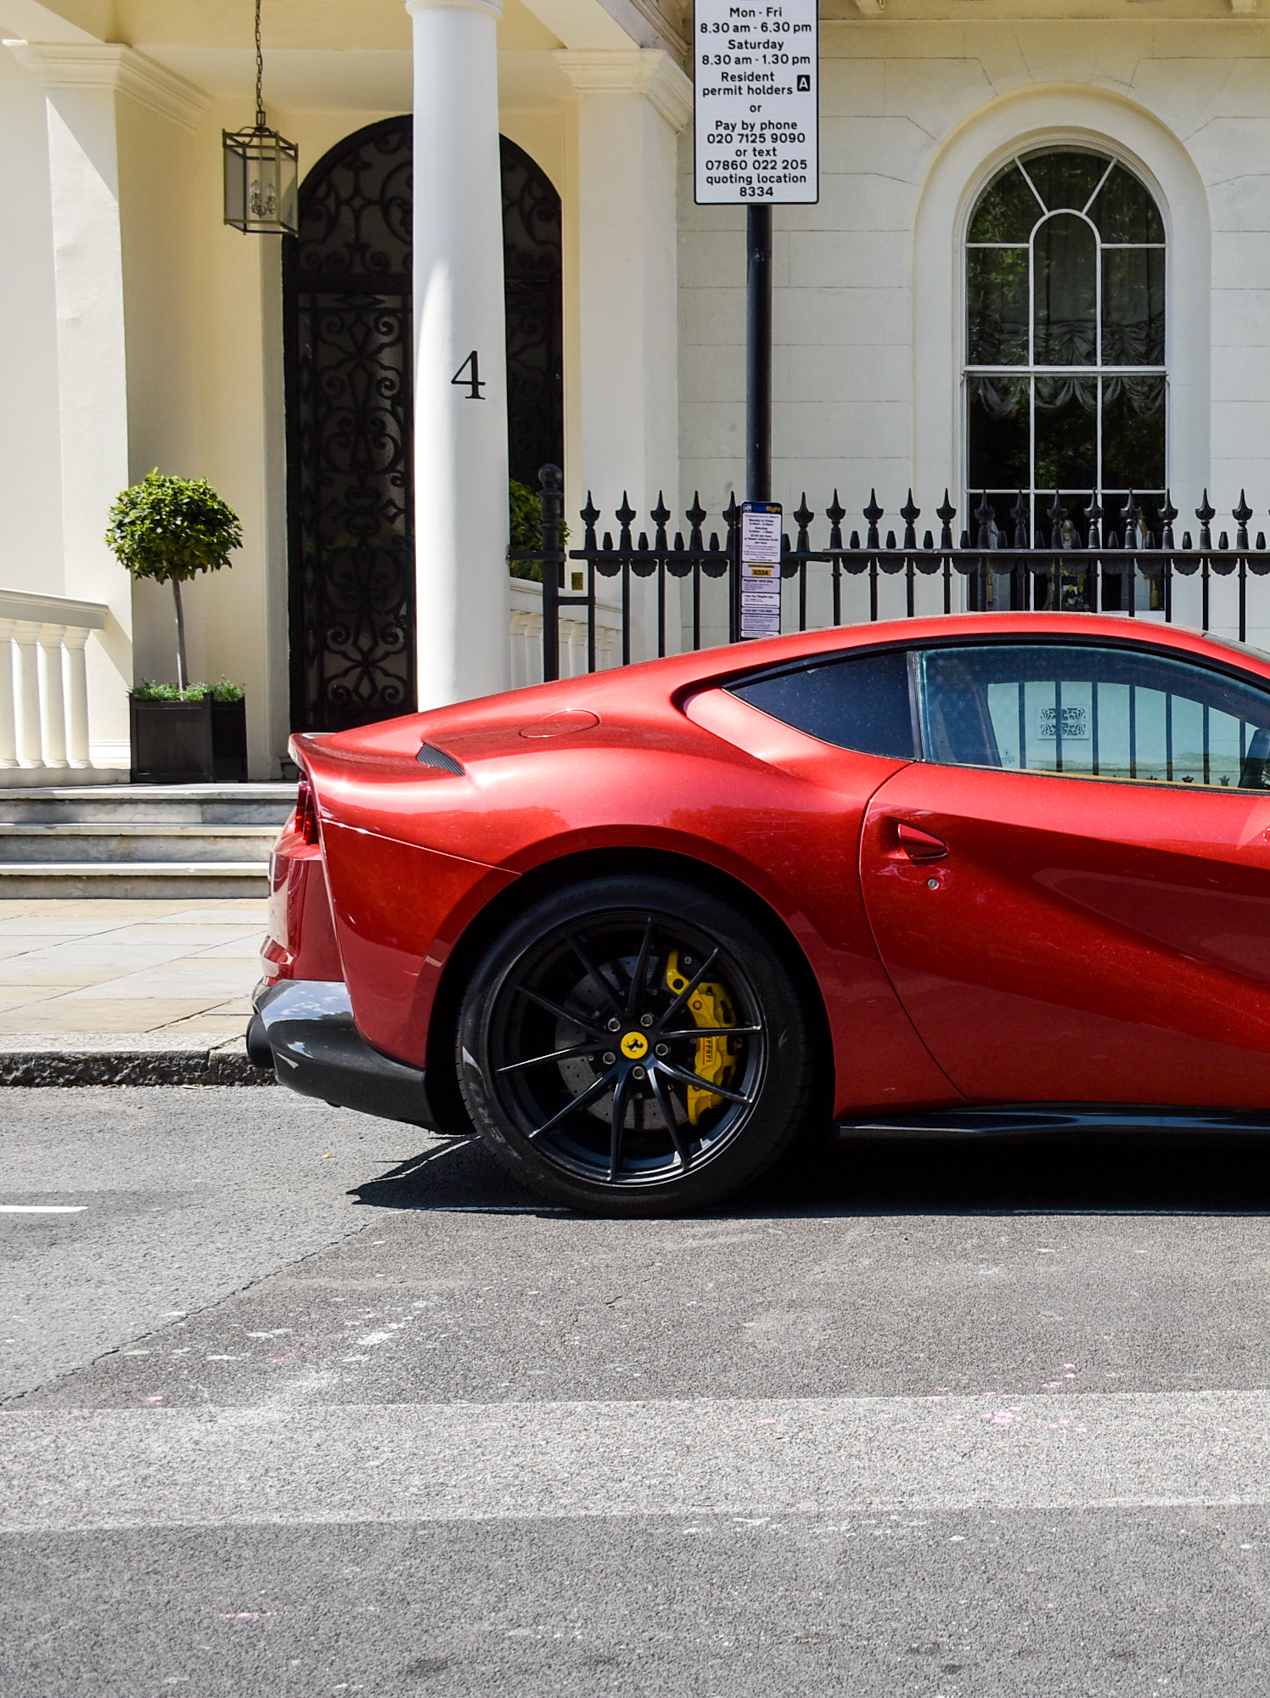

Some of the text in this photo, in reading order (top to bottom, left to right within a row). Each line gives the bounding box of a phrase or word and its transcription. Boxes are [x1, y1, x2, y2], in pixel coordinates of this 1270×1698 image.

[730, 7, 755, 17] Mon
[766, 7, 782, 17] Fri
[700, 22, 729, 33] 8.30
[733, 25, 750, 33] am
[761, 22, 790, 32] 6.30
[793, 24, 811, 34] pm
[728, 39, 784, 51] Saturday
[702, 54, 731, 65] 8.30
[734, 57, 752, 65] am
[762, 54, 789, 64] 1.30
[792, 56, 810, 66] pm
[721, 71, 775, 82] Resident
[799, 78, 808, 88] A
[703, 85, 793, 97] permit holders
[750, 105, 762, 113] or
[716, 120, 797, 132] Pay by phone
[707, 133, 805, 144] 020 7125 9090
[735, 147, 777, 157] or text
[706, 159, 807, 170] 07860 022 205
[706, 173, 806, 185] quoting location
[740, 186, 774, 197] 8334
[451, 351, 485, 400] 4
